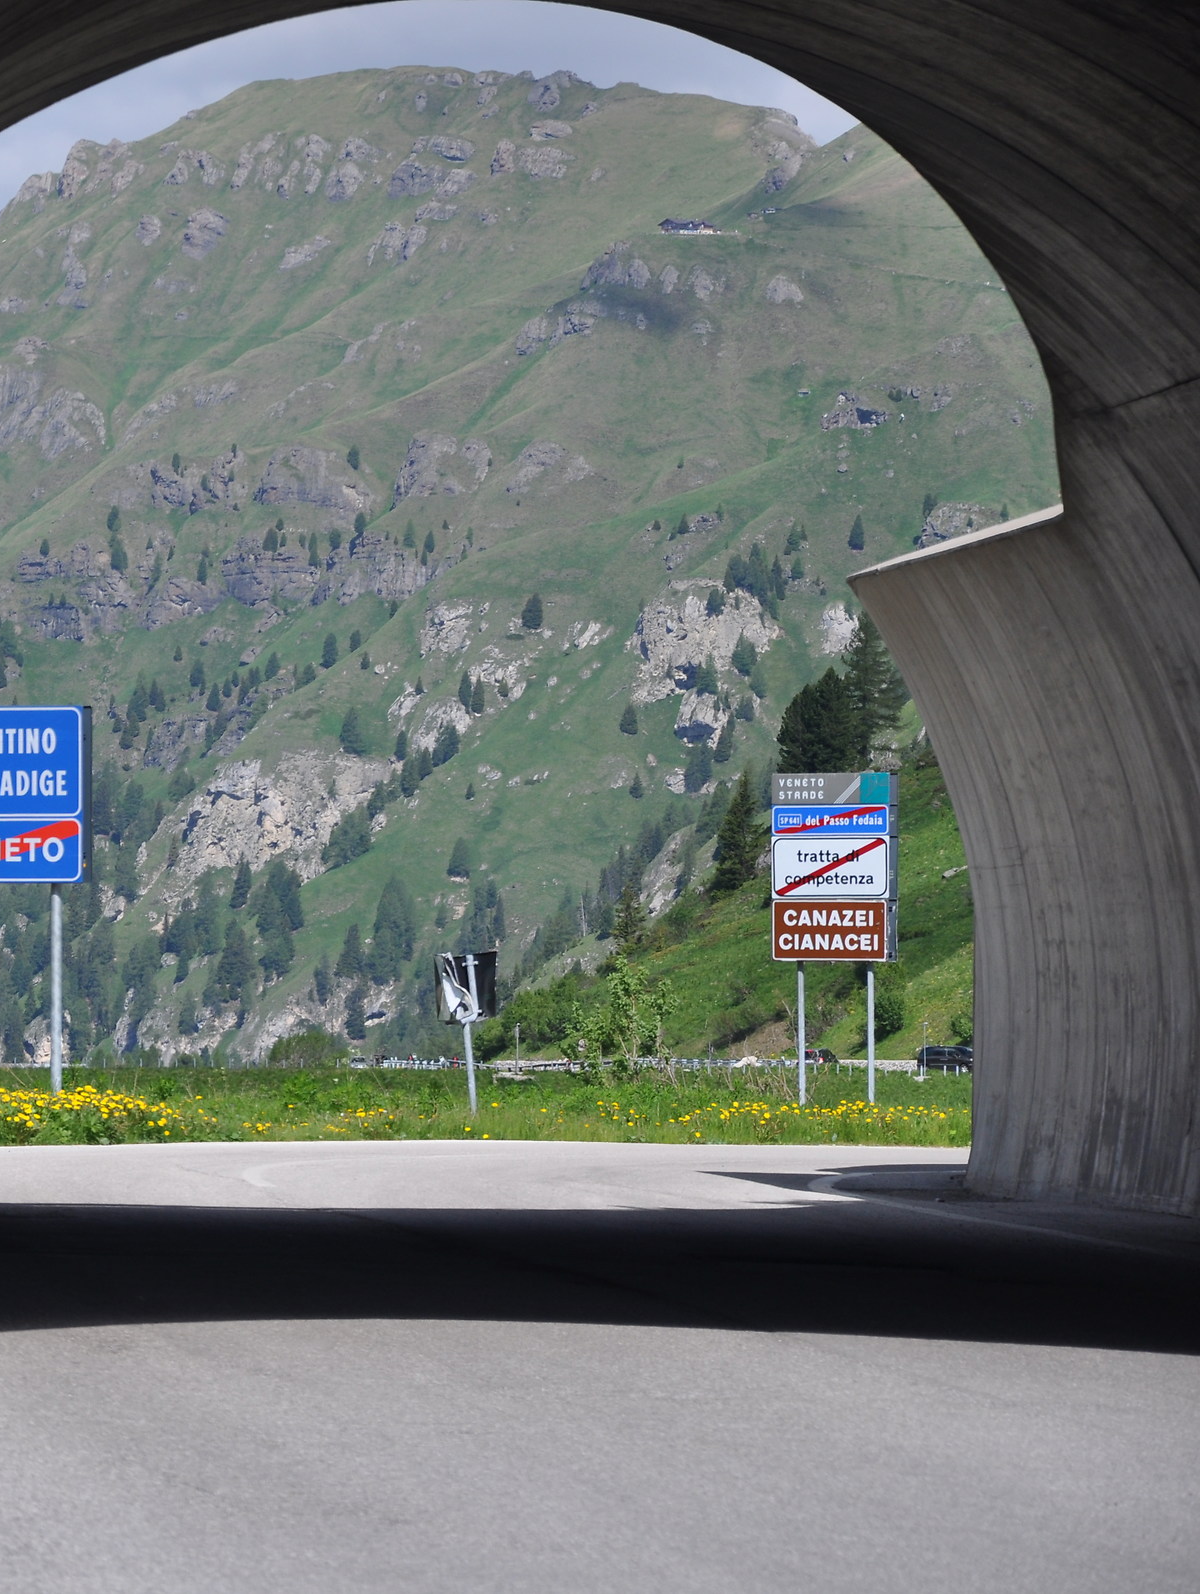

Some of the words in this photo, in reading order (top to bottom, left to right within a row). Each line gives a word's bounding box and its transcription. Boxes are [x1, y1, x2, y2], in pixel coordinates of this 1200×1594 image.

[0, 770, 68, 796] ADIGE
[778, 778, 824, 787] VENETO
[778, 791, 824, 800] STRADE
[805, 816, 820, 826] del
[823, 815, 850, 826] Passo
[853, 814, 883, 825] Fedaia
[797, 850, 839, 863] tratta
[846, 849, 860, 862] di
[785, 872, 874, 887] competenza
[783, 909, 874, 927] CANAZEI
[778, 933, 879, 951] CIANACEI
